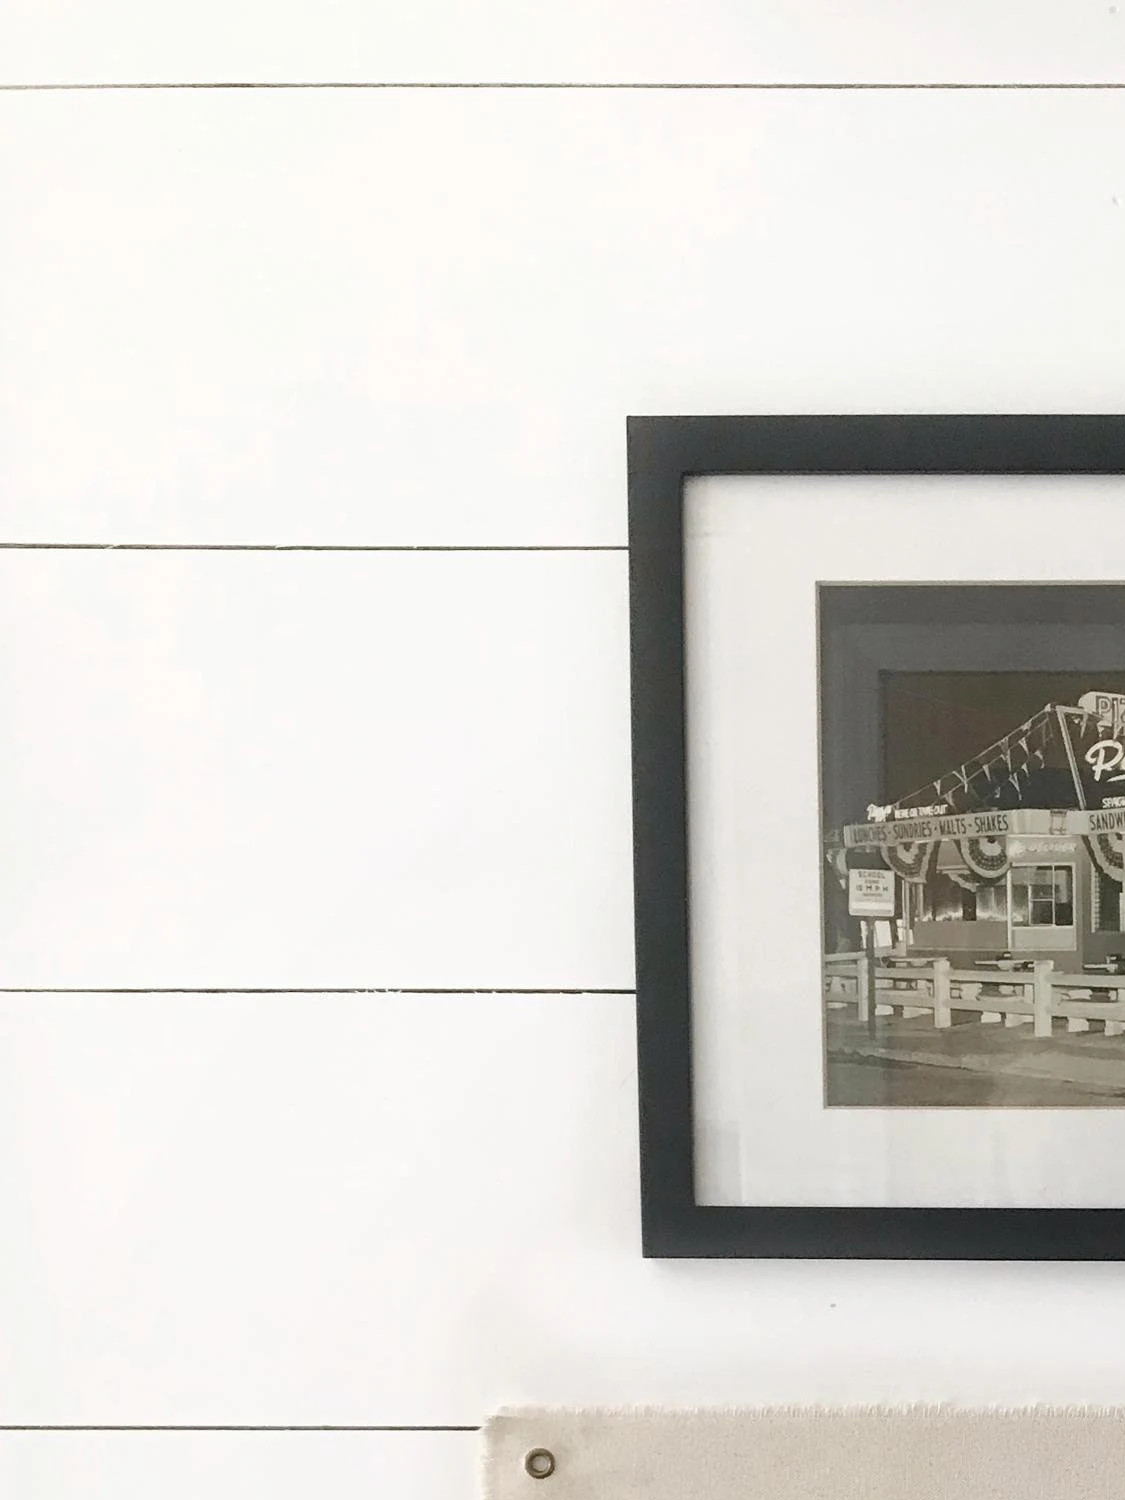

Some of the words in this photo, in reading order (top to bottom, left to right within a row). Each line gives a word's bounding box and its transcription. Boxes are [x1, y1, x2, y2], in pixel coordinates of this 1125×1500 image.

[893, 821, 932, 840] SUNDRIES
[940, 818, 967, 836] MALTS
[974, 814, 1009, 834] SHAKES
